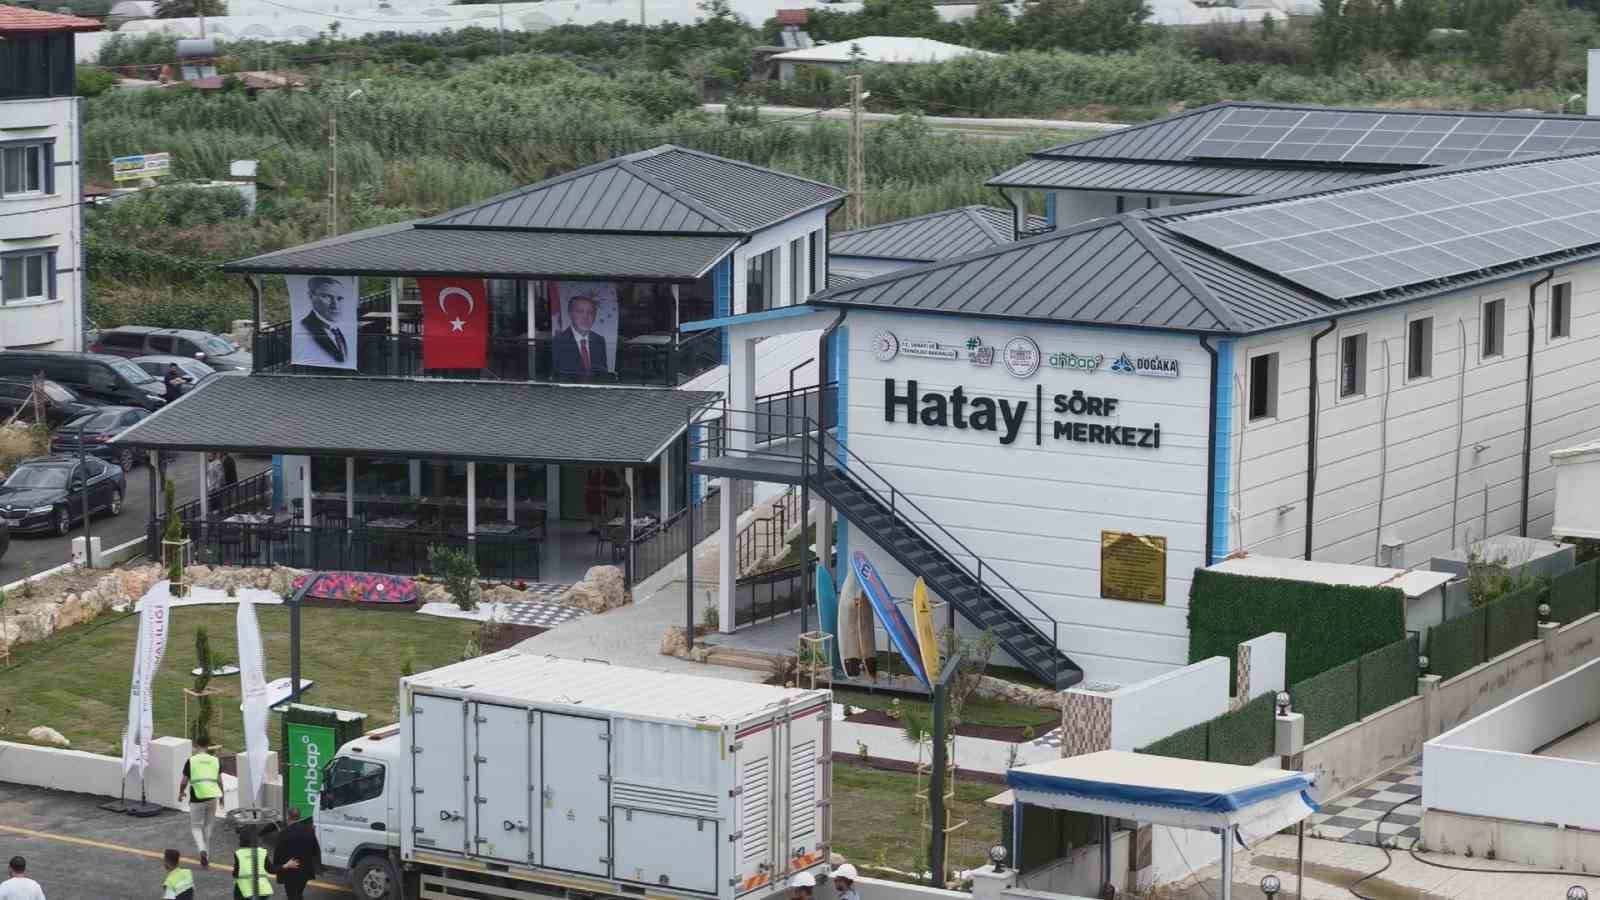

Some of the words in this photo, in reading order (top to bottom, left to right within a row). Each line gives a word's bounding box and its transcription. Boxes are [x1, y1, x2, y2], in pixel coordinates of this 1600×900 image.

[885, 378, 1028, 445] Hatay
[1054, 390, 1119, 417] SÖRF
[1054, 421, 1160, 448] MERKEZİ
